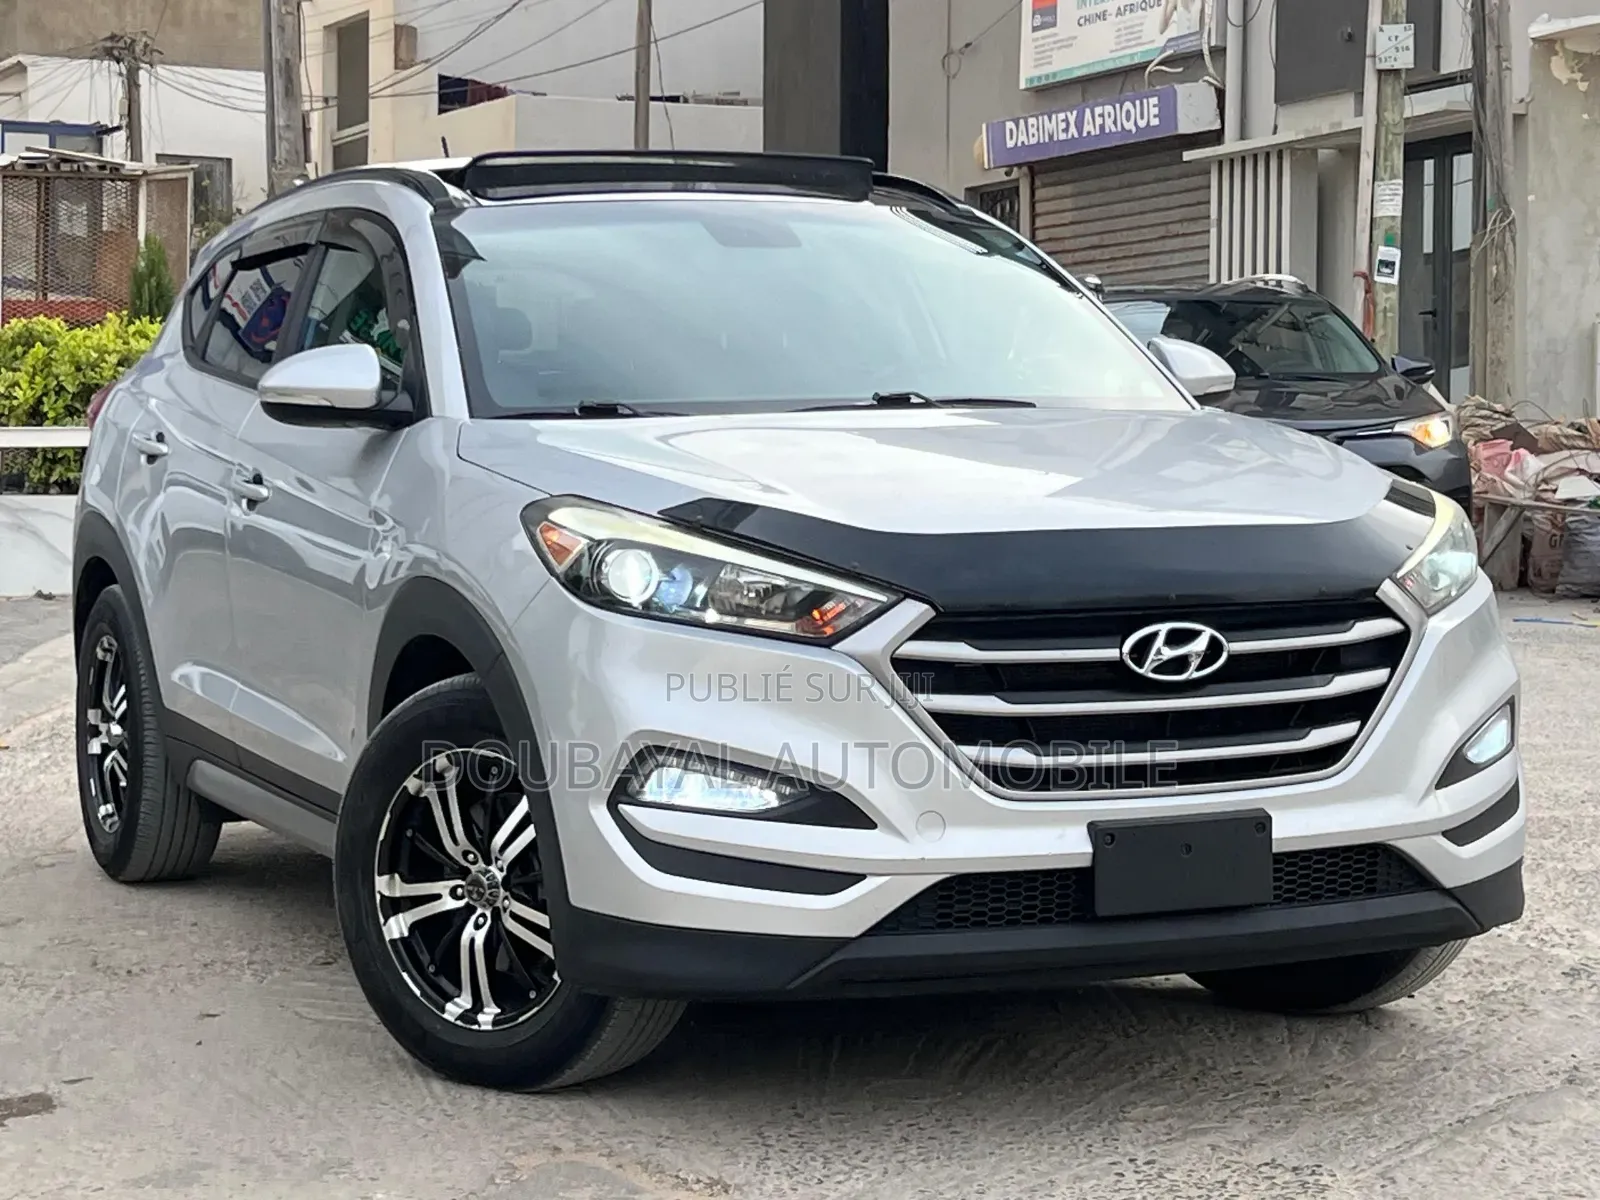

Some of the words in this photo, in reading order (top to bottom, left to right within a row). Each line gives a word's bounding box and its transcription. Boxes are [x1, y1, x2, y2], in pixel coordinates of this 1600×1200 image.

[1115, 0, 1163, 18] AFRIQUE
[1005, 110, 1079, 149] DABIMEX
[1082, 97, 1160, 134] AFRIQUE
